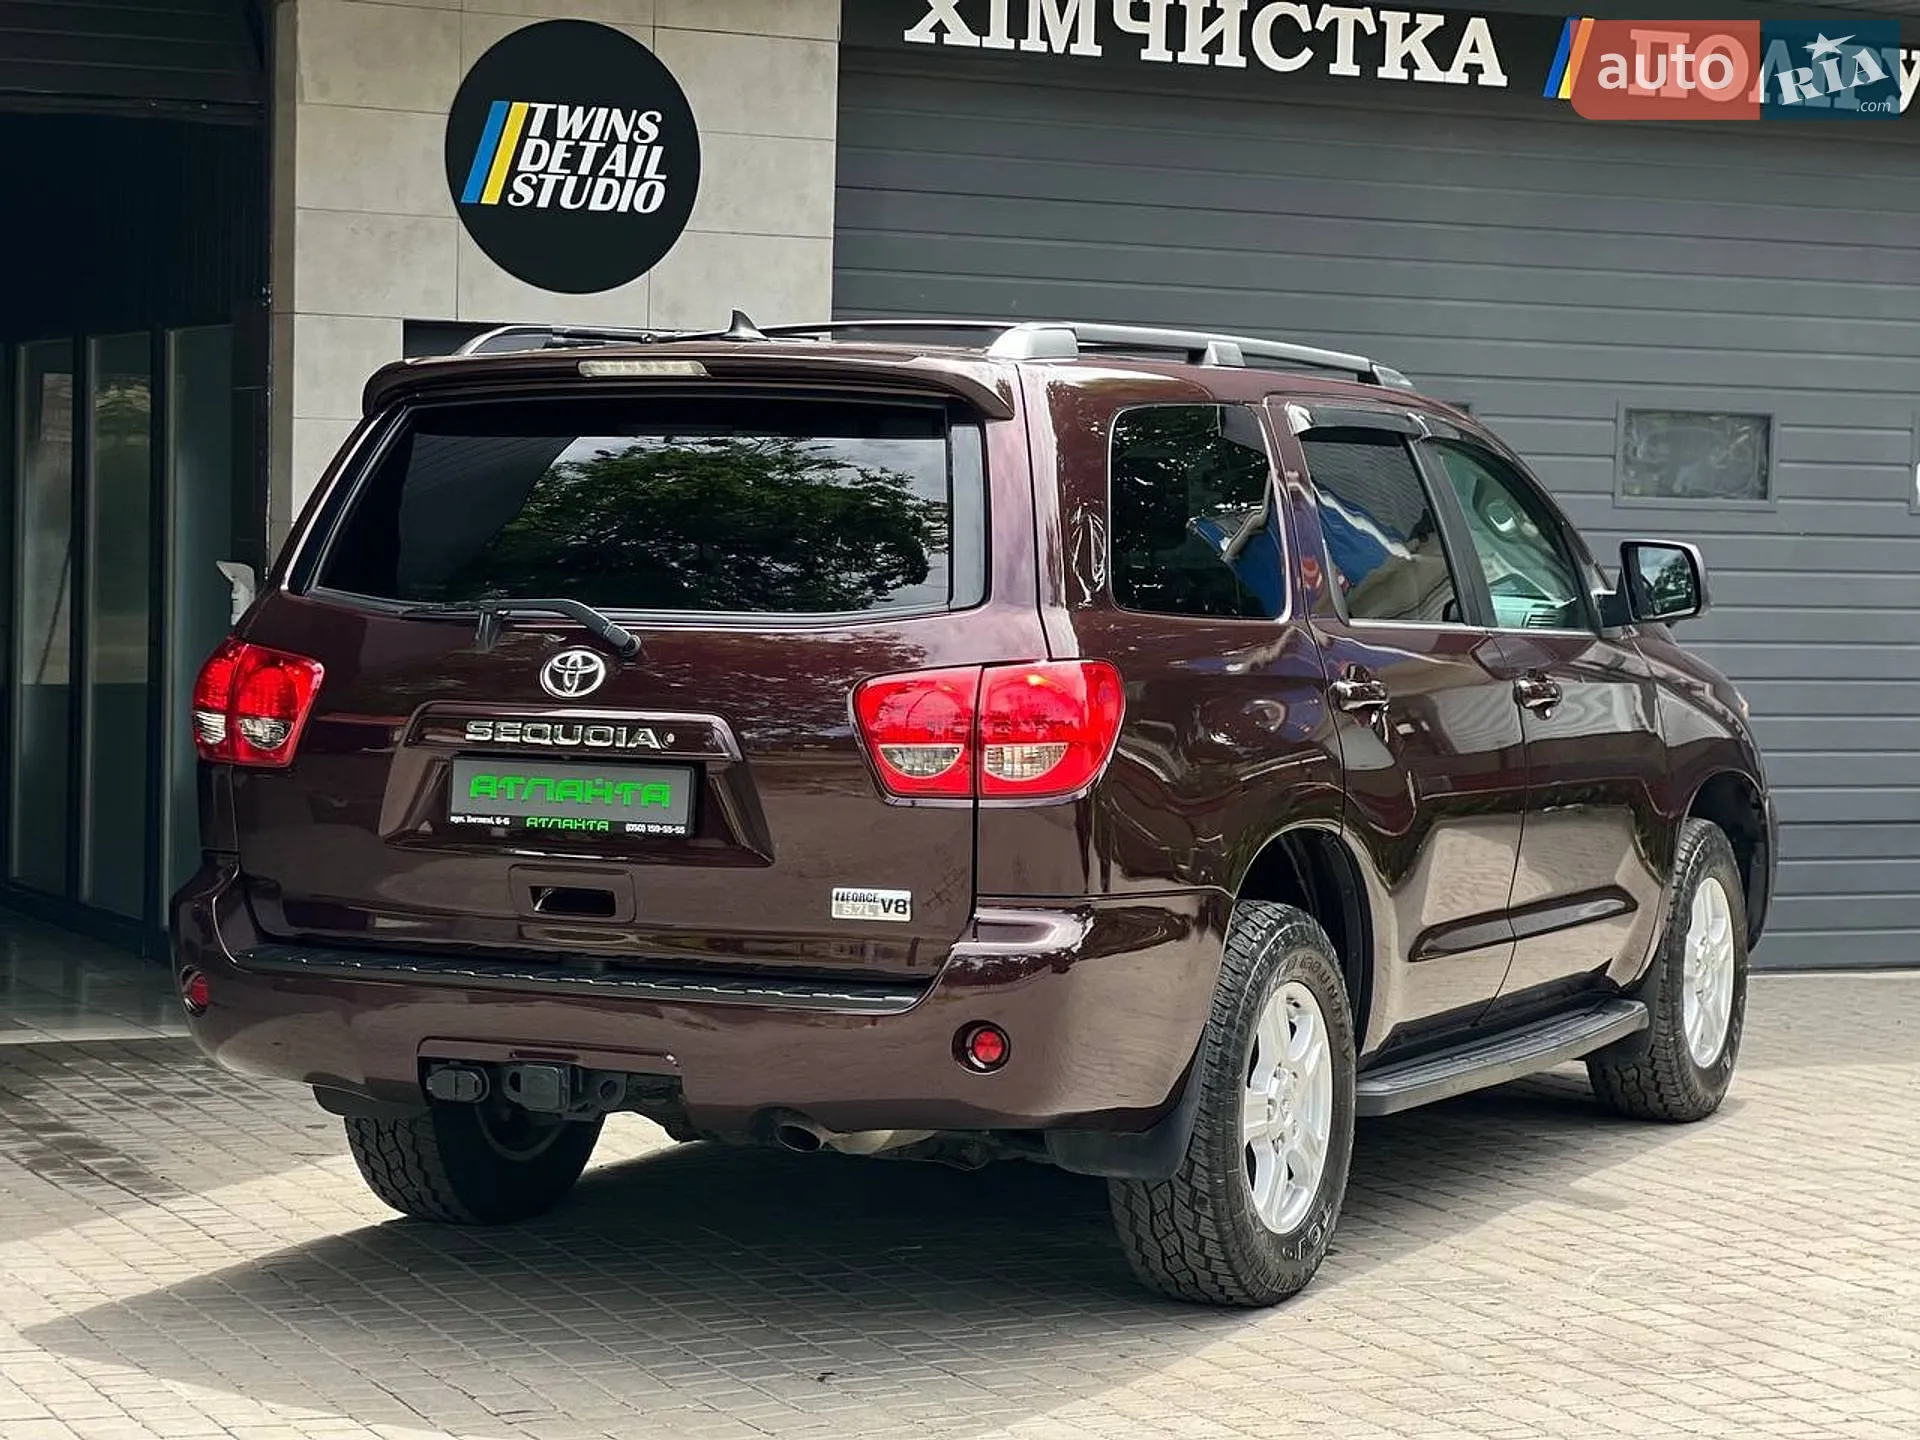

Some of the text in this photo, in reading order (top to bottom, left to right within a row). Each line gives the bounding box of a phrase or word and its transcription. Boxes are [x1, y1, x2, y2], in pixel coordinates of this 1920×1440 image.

[904, 0, 1508, 87] ХІМЧИСТКА
[528, 102, 663, 144] TWINS
[517, 138, 668, 180] DETAIL
[507, 173, 666, 214] STUDIO
[465, 719, 662, 750] SEQUOIA
[469, 773, 672, 809] АТЛАНТА
[526, 816, 610, 832] АТЛАНТА
[880, 898, 908, 915] V8
